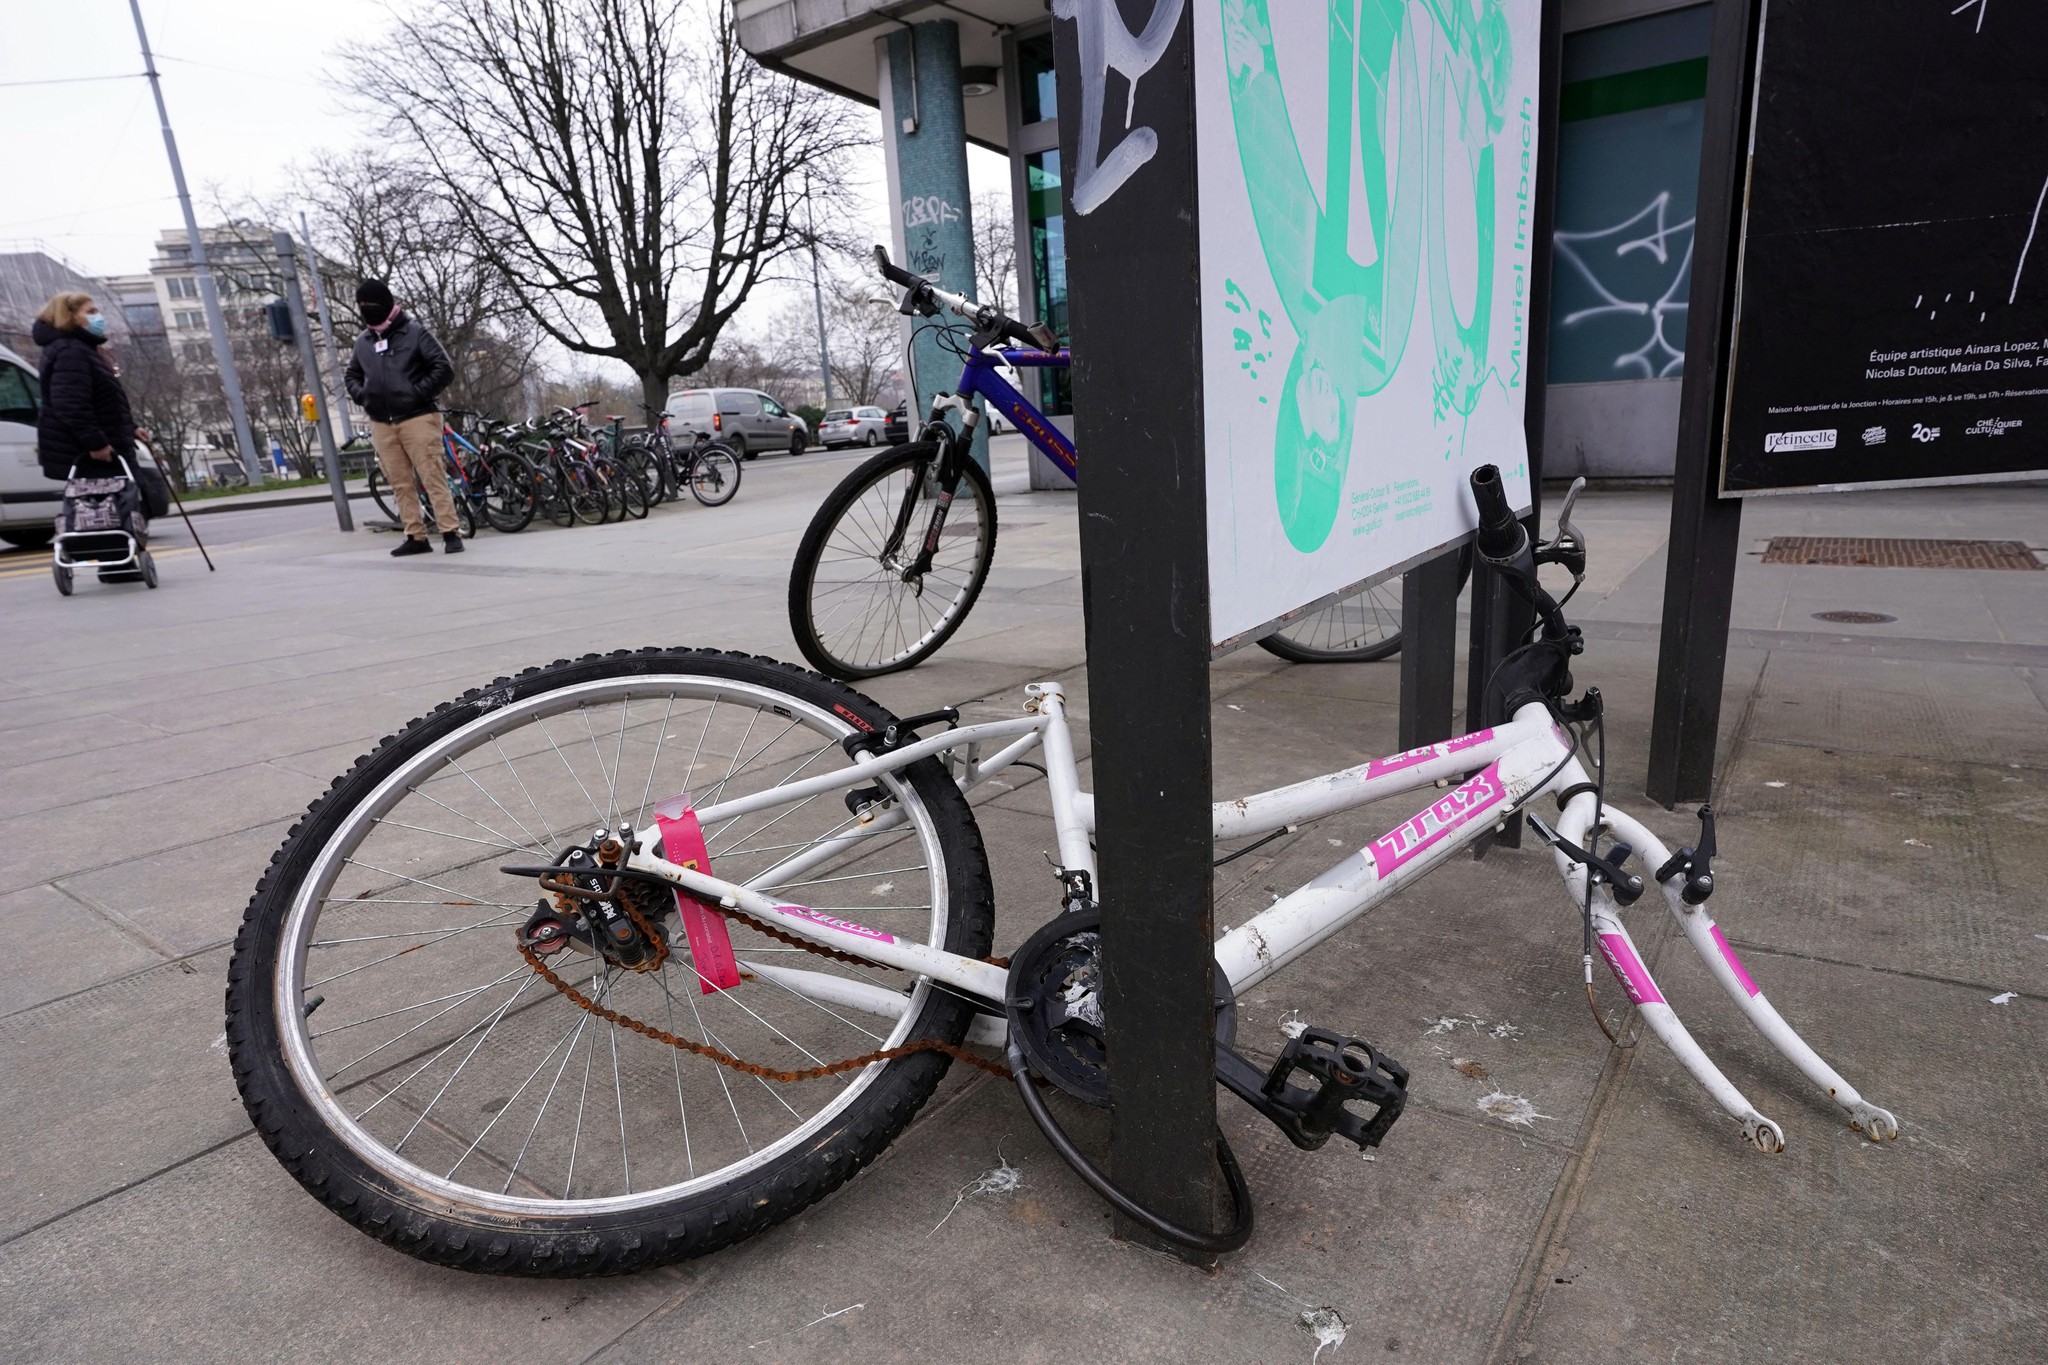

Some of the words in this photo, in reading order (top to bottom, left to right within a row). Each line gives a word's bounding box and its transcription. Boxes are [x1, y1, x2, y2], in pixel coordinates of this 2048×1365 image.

[1514, 97, 1531, 250] Imbach
[1510, 264, 1523, 388] Muriel
[1869, 349, 1907, 363] Équipe
[1910, 346, 1962, 360] artistique
[1965, 344, 2001, 355] Ainara
[2004, 341, 2040, 353] Lopez,
[1866, 367, 1905, 379] Nicolas
[1908, 365, 1947, 377] Dutour,
[1950, 362, 1982, 373] Maria
[1985, 360, 2000, 370] Da
[2003, 358, 2033, 369] Silva,
[1768, 406, 1793, 414] Maison
[1794, 405, 1803, 413] de
[1803, 402, 1830, 412] quartier
[1831, 402, 1840, 410] de
[1841, 401, 1848, 409] la
[1848, 400, 1878, 409] Jonction
[1013, 402, 1076, 467] CROSS
[842, 709, 873, 732] WANDA
